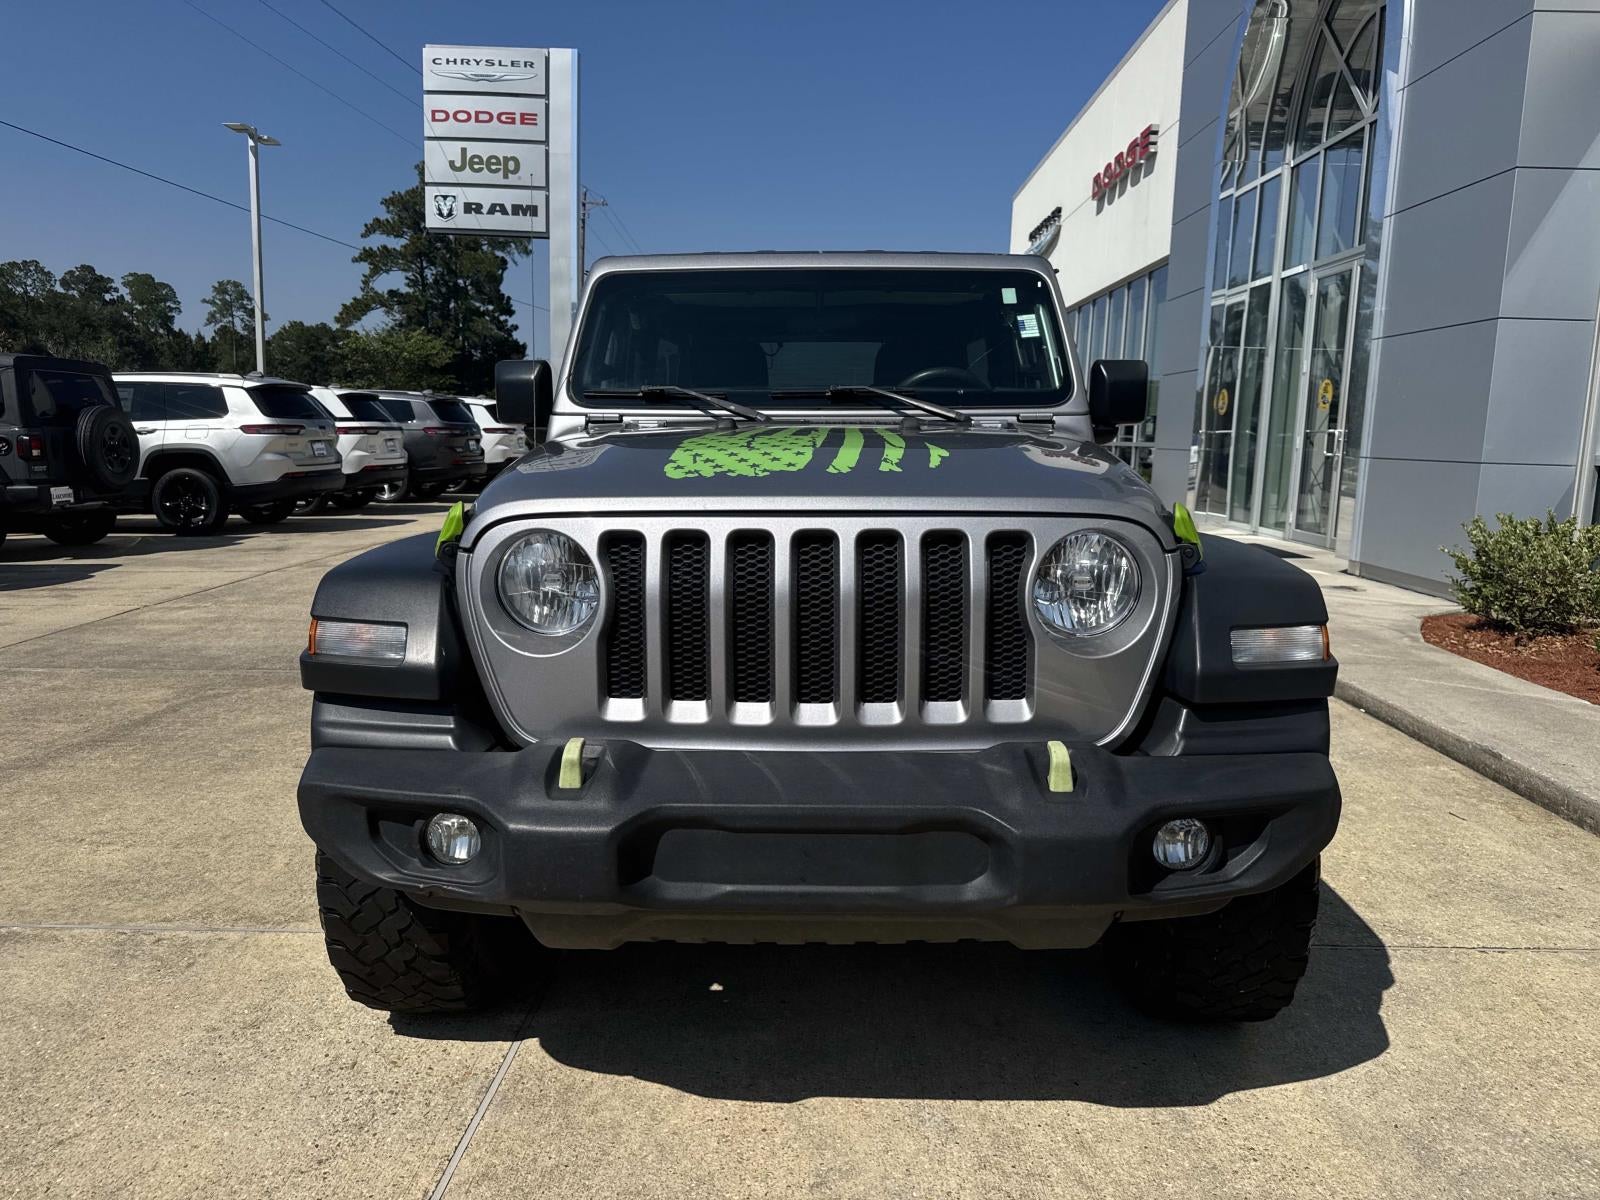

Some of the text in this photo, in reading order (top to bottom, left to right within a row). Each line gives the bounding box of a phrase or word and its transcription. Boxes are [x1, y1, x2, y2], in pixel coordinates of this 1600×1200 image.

[432, 57, 535, 69] CHRYSLER
[431, 109, 538, 126] DODGE
[449, 147, 521, 179] Jeep
[1092, 124, 1157, 201] DODGE
[463, 202, 538, 218] RAM
